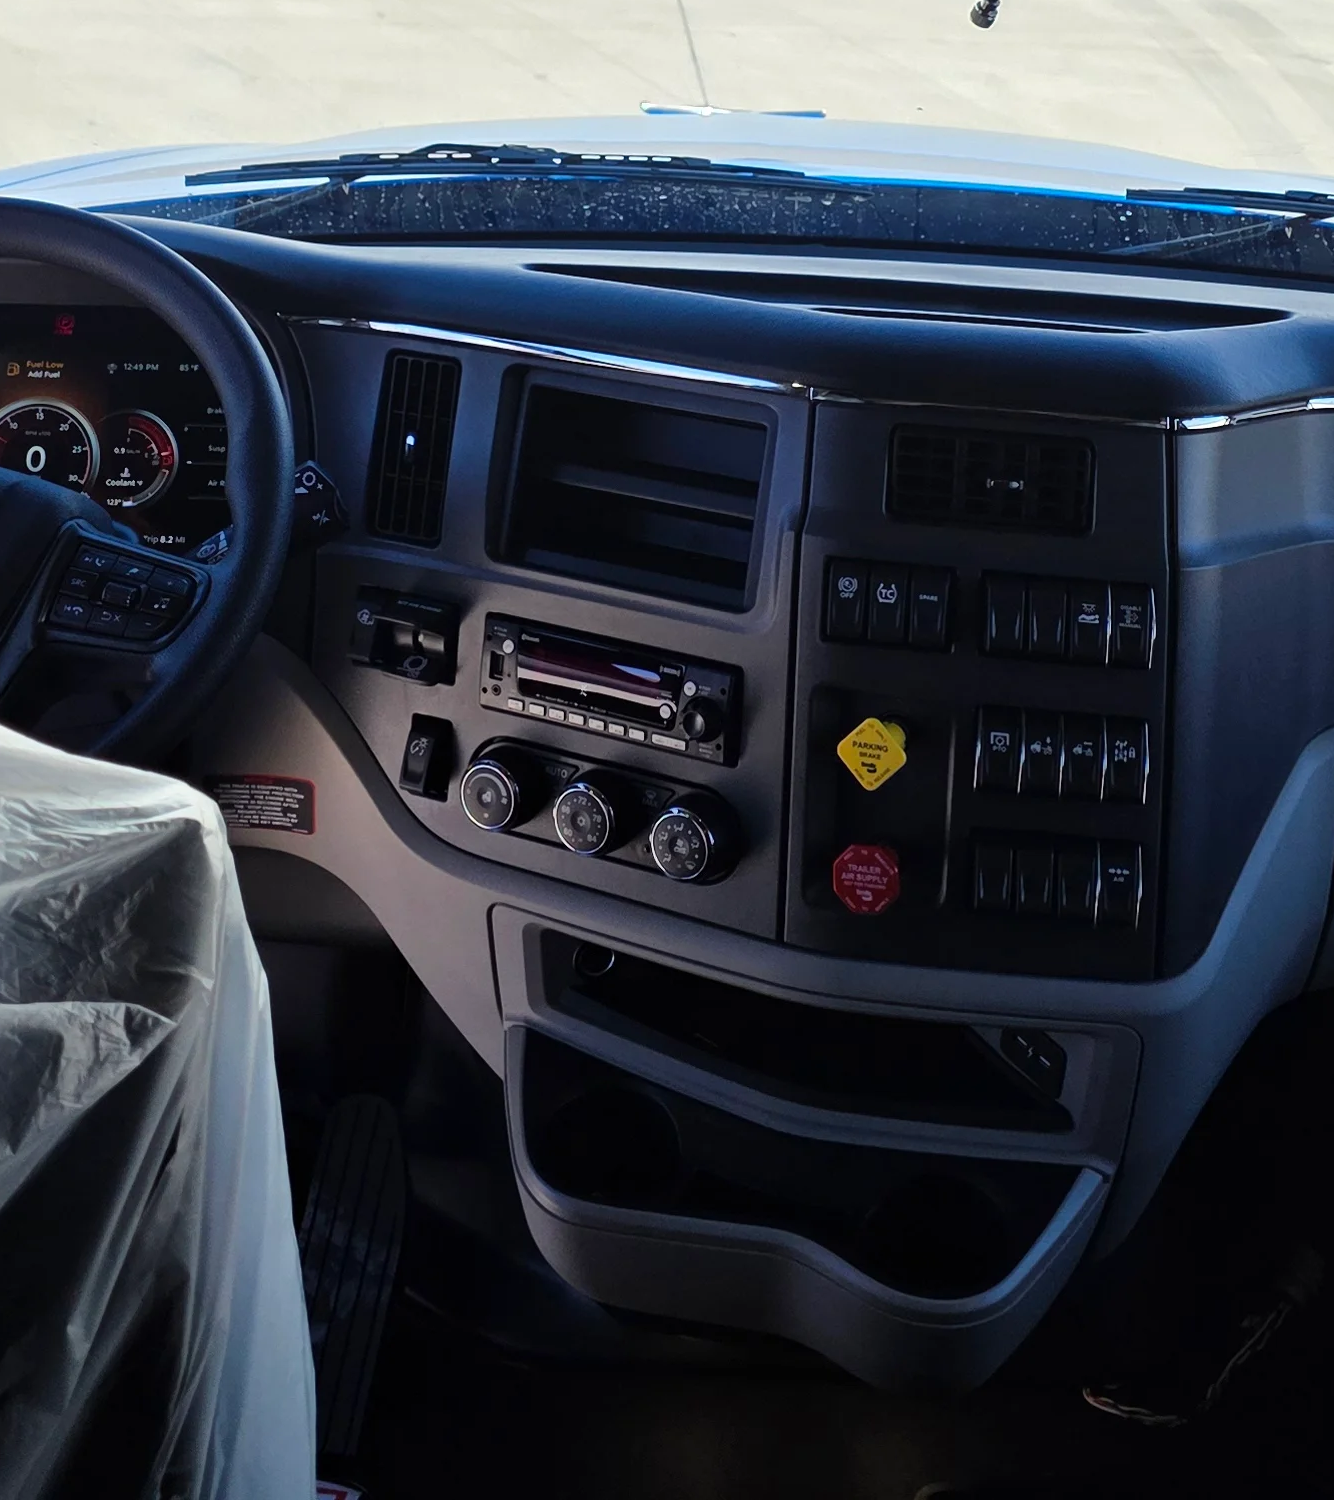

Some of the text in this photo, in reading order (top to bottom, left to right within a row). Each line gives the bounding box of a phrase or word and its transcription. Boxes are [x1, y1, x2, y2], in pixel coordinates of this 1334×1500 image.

[26, 361, 64, 369] Fuel Low
[123, 363, 144, 371] 12:49
[44, 370, 61, 378] Fuel
[10, 422, 19, 430] 10
[59, 424, 70, 432] 20
[72, 446, 83, 454] 25
[25, 445, 47, 473] 0
[68, 474, 79, 482] 30
[106, 479, 136, 487] Coolant
[160, 535, 173, 544] 8.2
[70, 578, 88, 588] SRC
[880, 589, 894, 599] TC
[852, 740, 889, 753] PARKING
[859, 751, 881, 760] BRAKE
[545, 765, 568, 779] AUTO
[577, 796, 588, 806] 72
[848, 864, 881, 875] TRAILER
[841, 872, 888, 885] AIR SUPPLY
